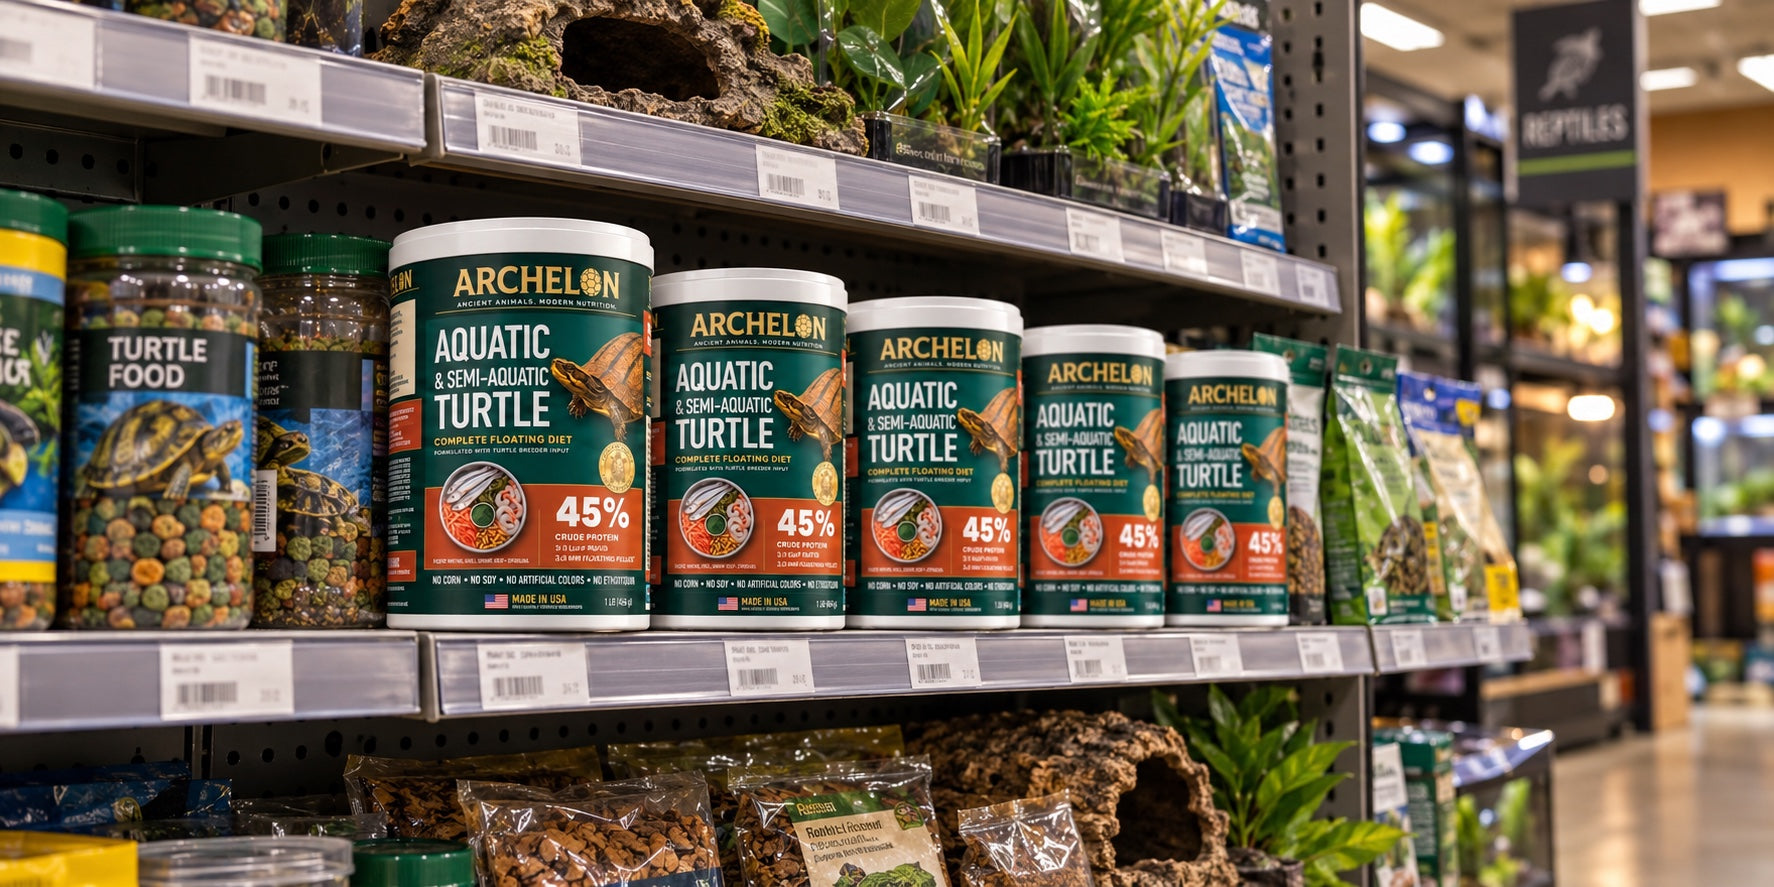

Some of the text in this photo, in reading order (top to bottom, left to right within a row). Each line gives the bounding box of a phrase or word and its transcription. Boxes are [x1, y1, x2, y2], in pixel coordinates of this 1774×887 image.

[1521, 103, 1628, 148] REPTILES
[453, 265, 620, 299] ARCHELON
[456, 299, 492, 308] ANCIENT
[539, 298, 574, 306] MODERN
[690, 311, 827, 341] ARCHELON
[107, 336, 208, 363] TURTLE
[434, 324, 550, 364] AQUATIC
[880, 336, 1004, 363] ARCHELON
[108, 363, 186, 389] FOOD
[434, 366, 549, 390] & SEMI-AQUATIC
[675, 361, 774, 393] AQUATIC
[1047, 361, 1153, 386] ARCHELON
[675, 396, 772, 415] & SEMI-AQUATIC
[867, 381, 958, 411] AQUATIC
[1188, 384, 1277, 406] ARCHELON
[433, 391, 551, 430] TURTLE
[868, 414, 957, 431] & SEMI-AQUATIC
[1036, 402, 1115, 428] AQUATIC
[434, 435, 572, 446] COMPLETE FLOATING DIET
[675, 417, 774, 450] TURTLE
[1044, 431, 1114, 447] SEMI-AQUATIC
[1177, 421, 1242, 445] AQUATIC
[675, 455, 792, 464] COMPLETE FLOATING DIET
[867, 433, 958, 463] TURTLE
[867, 467, 974, 476] COMPLETE FLOATING DIET
[1035, 448, 1115, 476] TURTLE
[1176, 463, 1242, 488] TURTLE
[555, 496, 630, 529] 45%
[777, 508, 835, 537] 45%
[554, 533, 619, 542] CRUDE PROTEIN
[962, 516, 1011, 543] 45%
[1119, 523, 1159, 549] 45%
[776, 541, 828, 549] CRUDE PROTEIN
[1248, 531, 1283, 555] 45%
[432, 575, 441, 585] NO
[443, 575, 461, 585] CORN
[470, 575, 481, 585] NO
[482, 575, 497, 585] SOY
[506, 575, 517, 585] NO
[518, 575, 556, 585] ARTIFICIAL
[558, 575, 585, 585] COLORS
[592, 575, 603, 585] NO
[683, 579, 699, 588] CORN
[706, 579, 715, 588] NO
[716, 579, 729, 588] SOY
[736, 579, 746, 588] NO
[747, 579, 779, 588] ARTIFICIAL
[779, 579, 801, 588] COLORS
[512, 594, 567, 604] MADE IN USA
[741, 597, 788, 606] MADE IN USA
